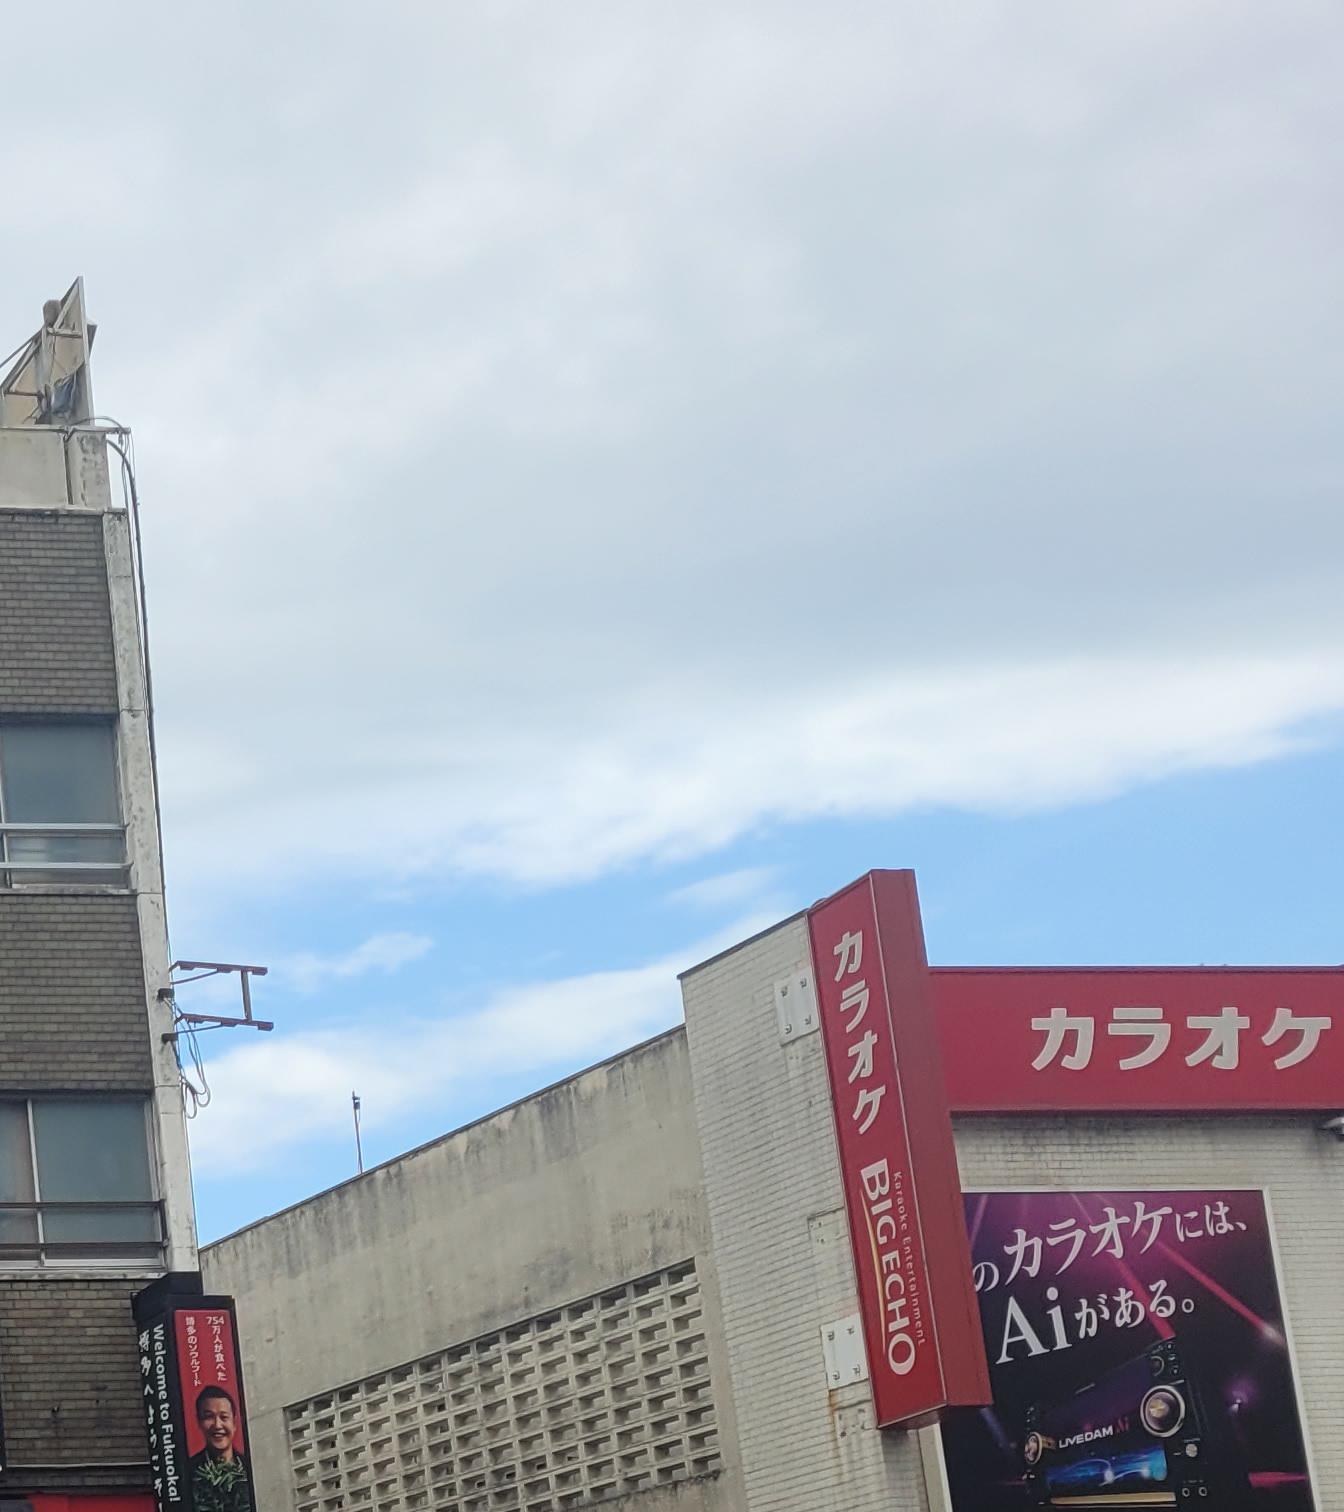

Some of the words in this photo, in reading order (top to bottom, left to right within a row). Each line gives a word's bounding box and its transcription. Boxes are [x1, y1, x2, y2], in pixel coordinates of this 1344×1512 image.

[833, 930, 886, 1135] カラオケ
[1031, 1006, 1332, 1070] カラオケ
[860, 1158, 896, 1245] BIG
[879, 1248, 917, 1376] ECHO
[153, 1325, 168, 1402] Welcome
[162, 1424, 181, 1502] Fukuoka!
[1059, 1425, 1113, 1449] LIVEDAM
